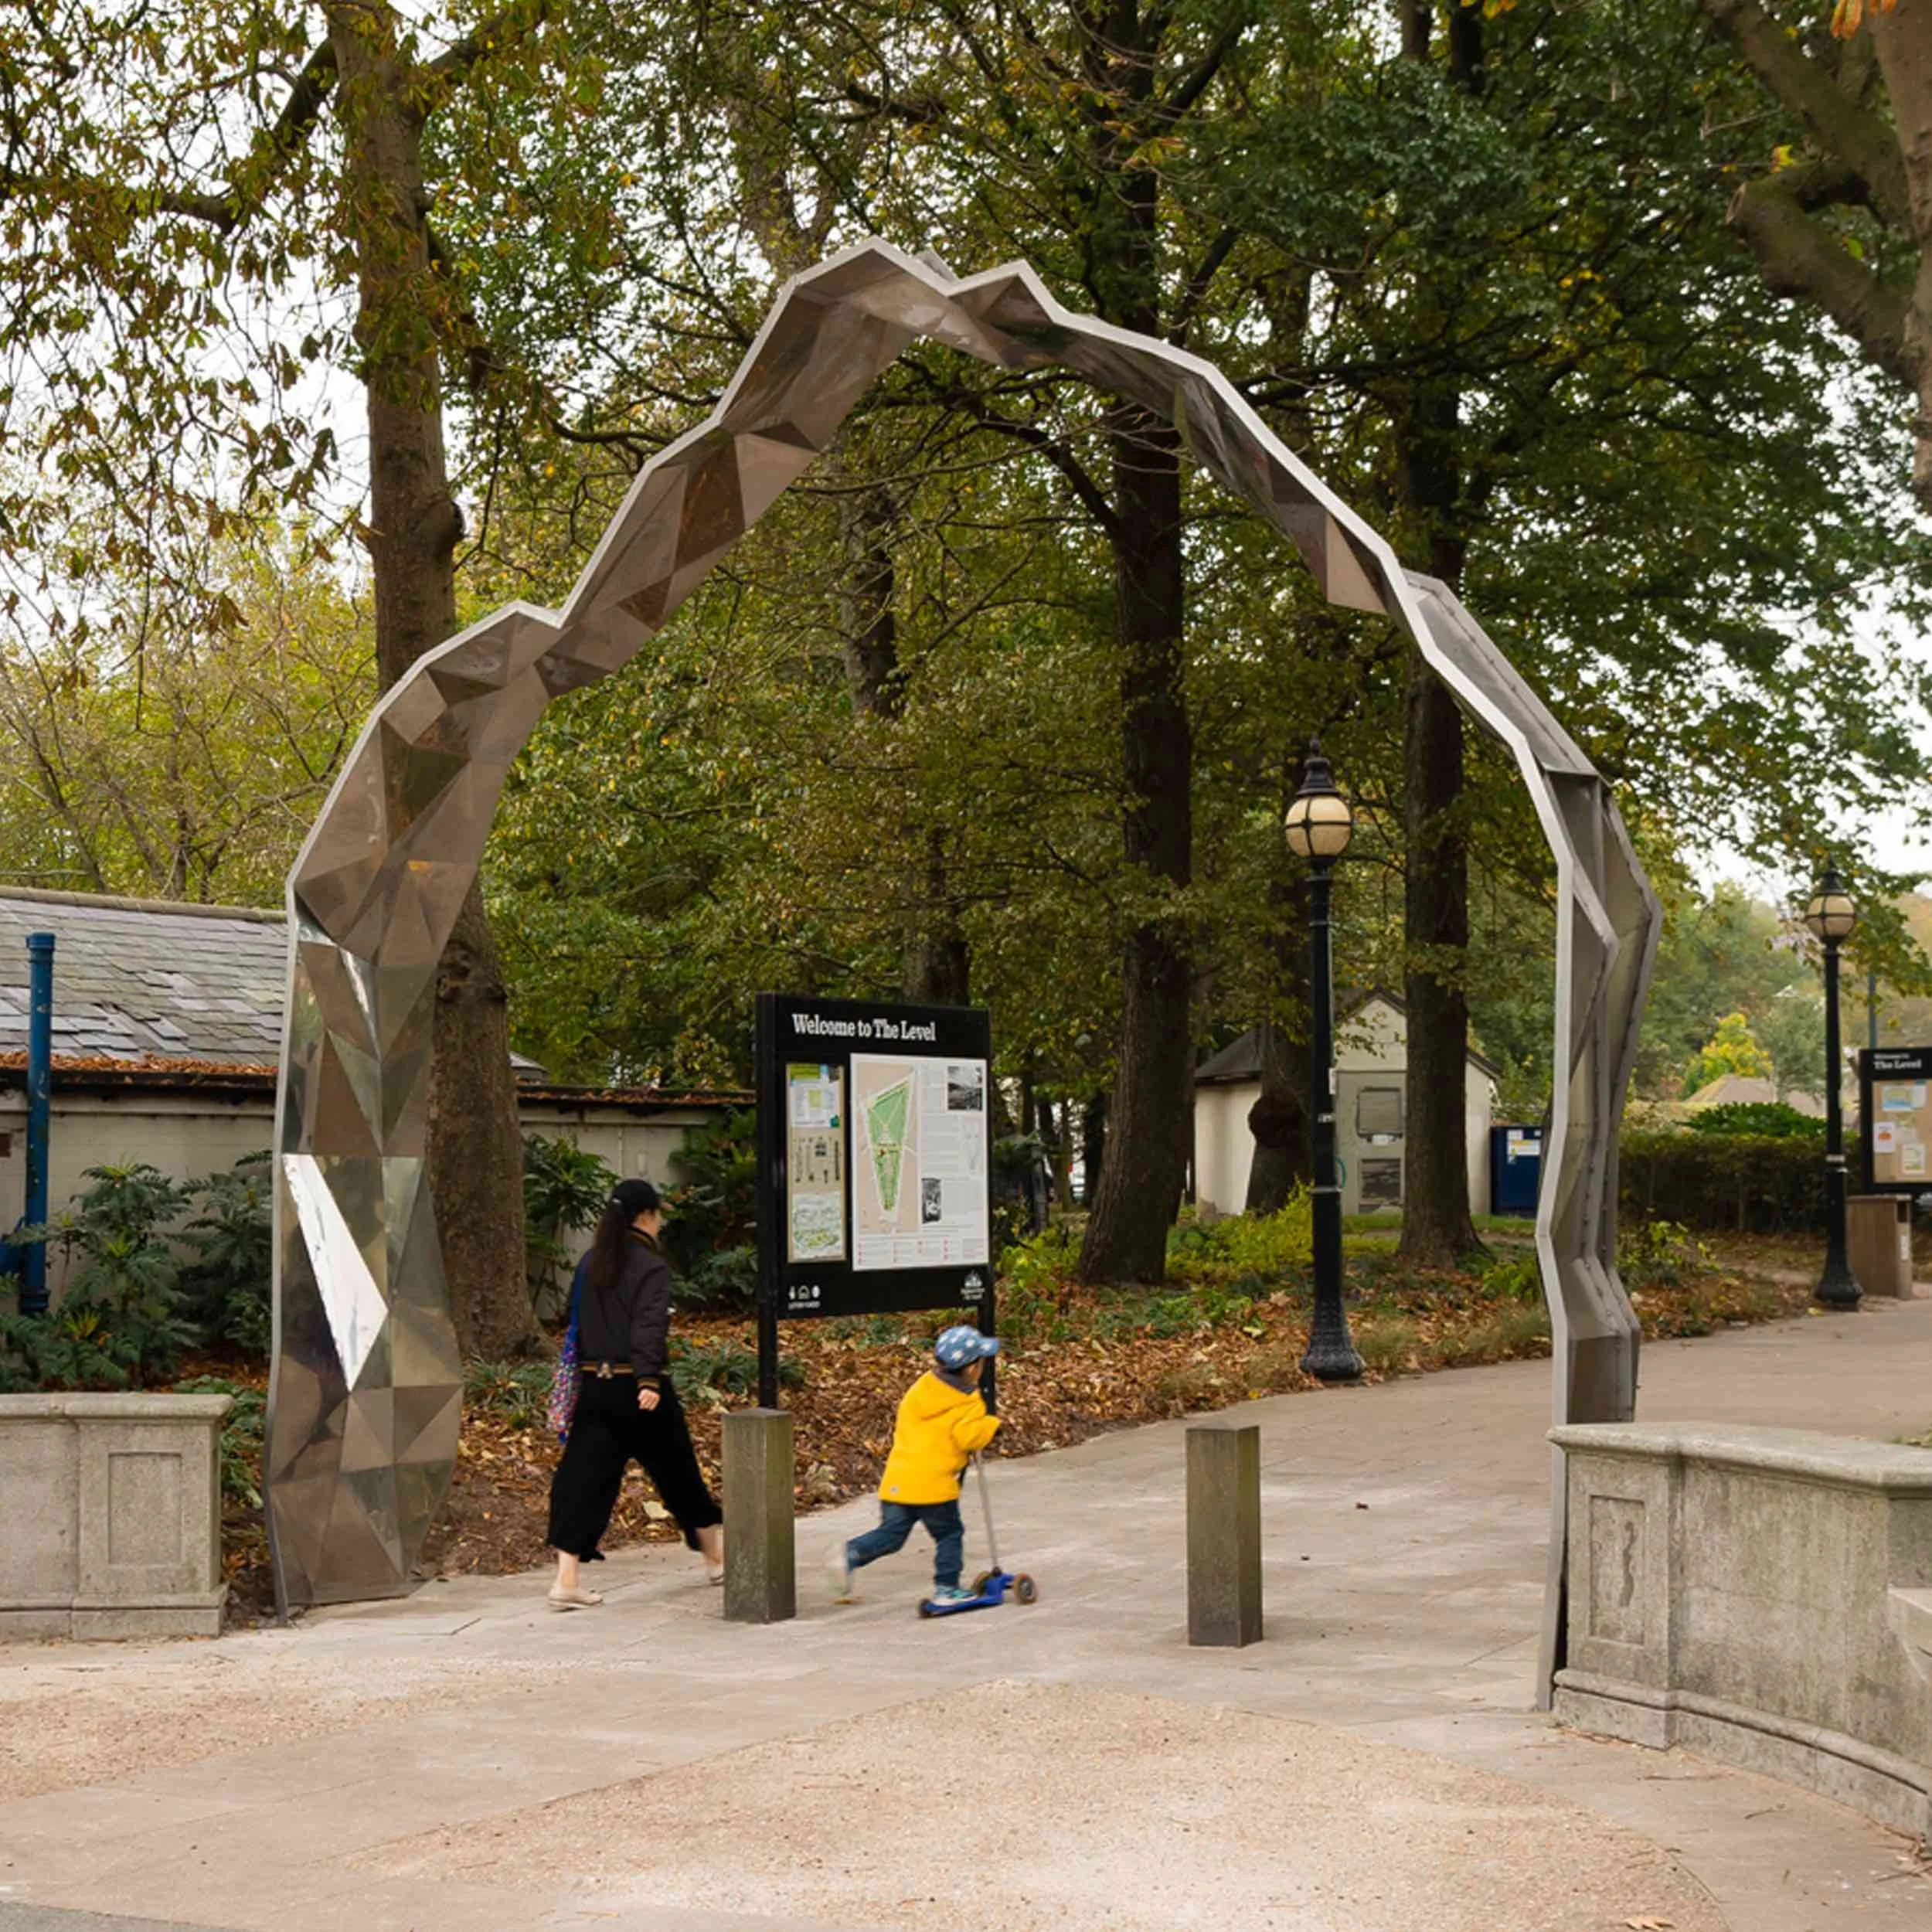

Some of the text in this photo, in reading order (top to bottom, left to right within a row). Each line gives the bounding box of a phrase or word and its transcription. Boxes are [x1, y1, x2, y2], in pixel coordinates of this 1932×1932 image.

[792, 1013, 936, 1041] Welcome to The Level
[1873, 1061, 1893, 1070] The
